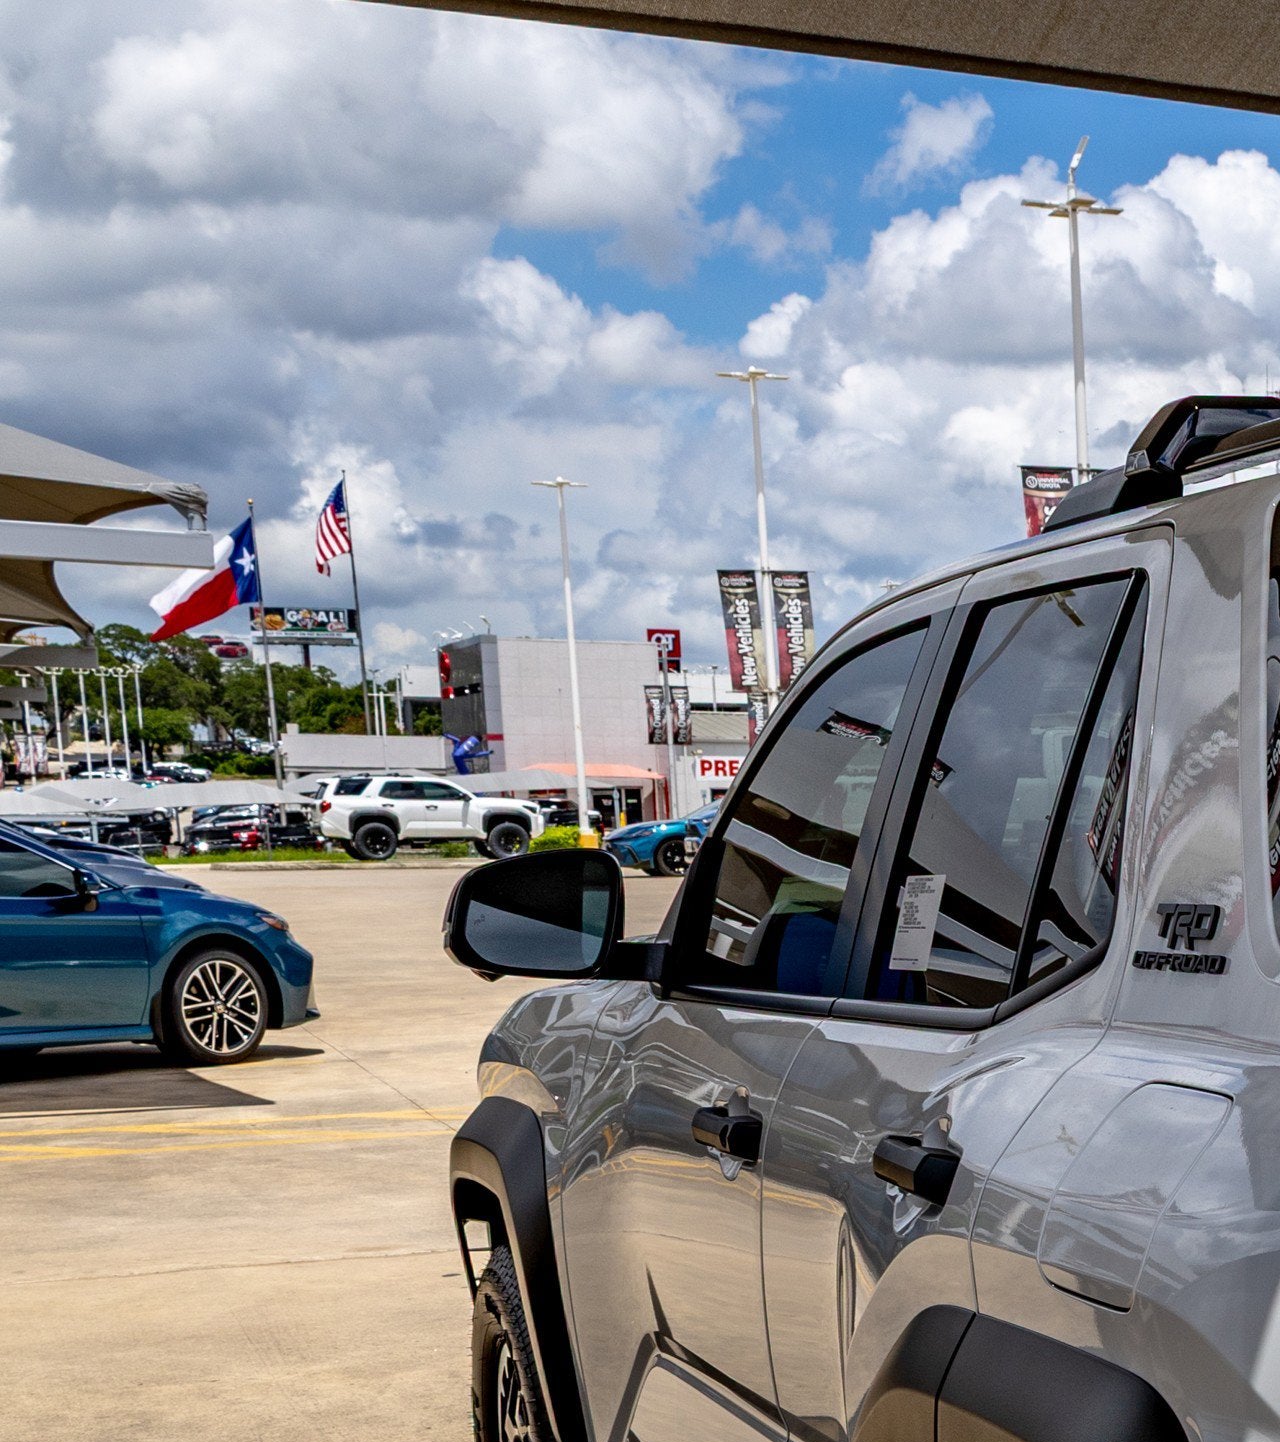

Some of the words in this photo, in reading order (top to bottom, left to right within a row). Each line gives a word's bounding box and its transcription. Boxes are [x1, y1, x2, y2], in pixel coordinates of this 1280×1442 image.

[733, 598, 754, 654] Vehicles
[785, 598, 805, 653] Vehicles
[741, 656, 758, 686] New
[700, 759, 740, 777] PRE
[1156, 903, 1221, 951] TRD
